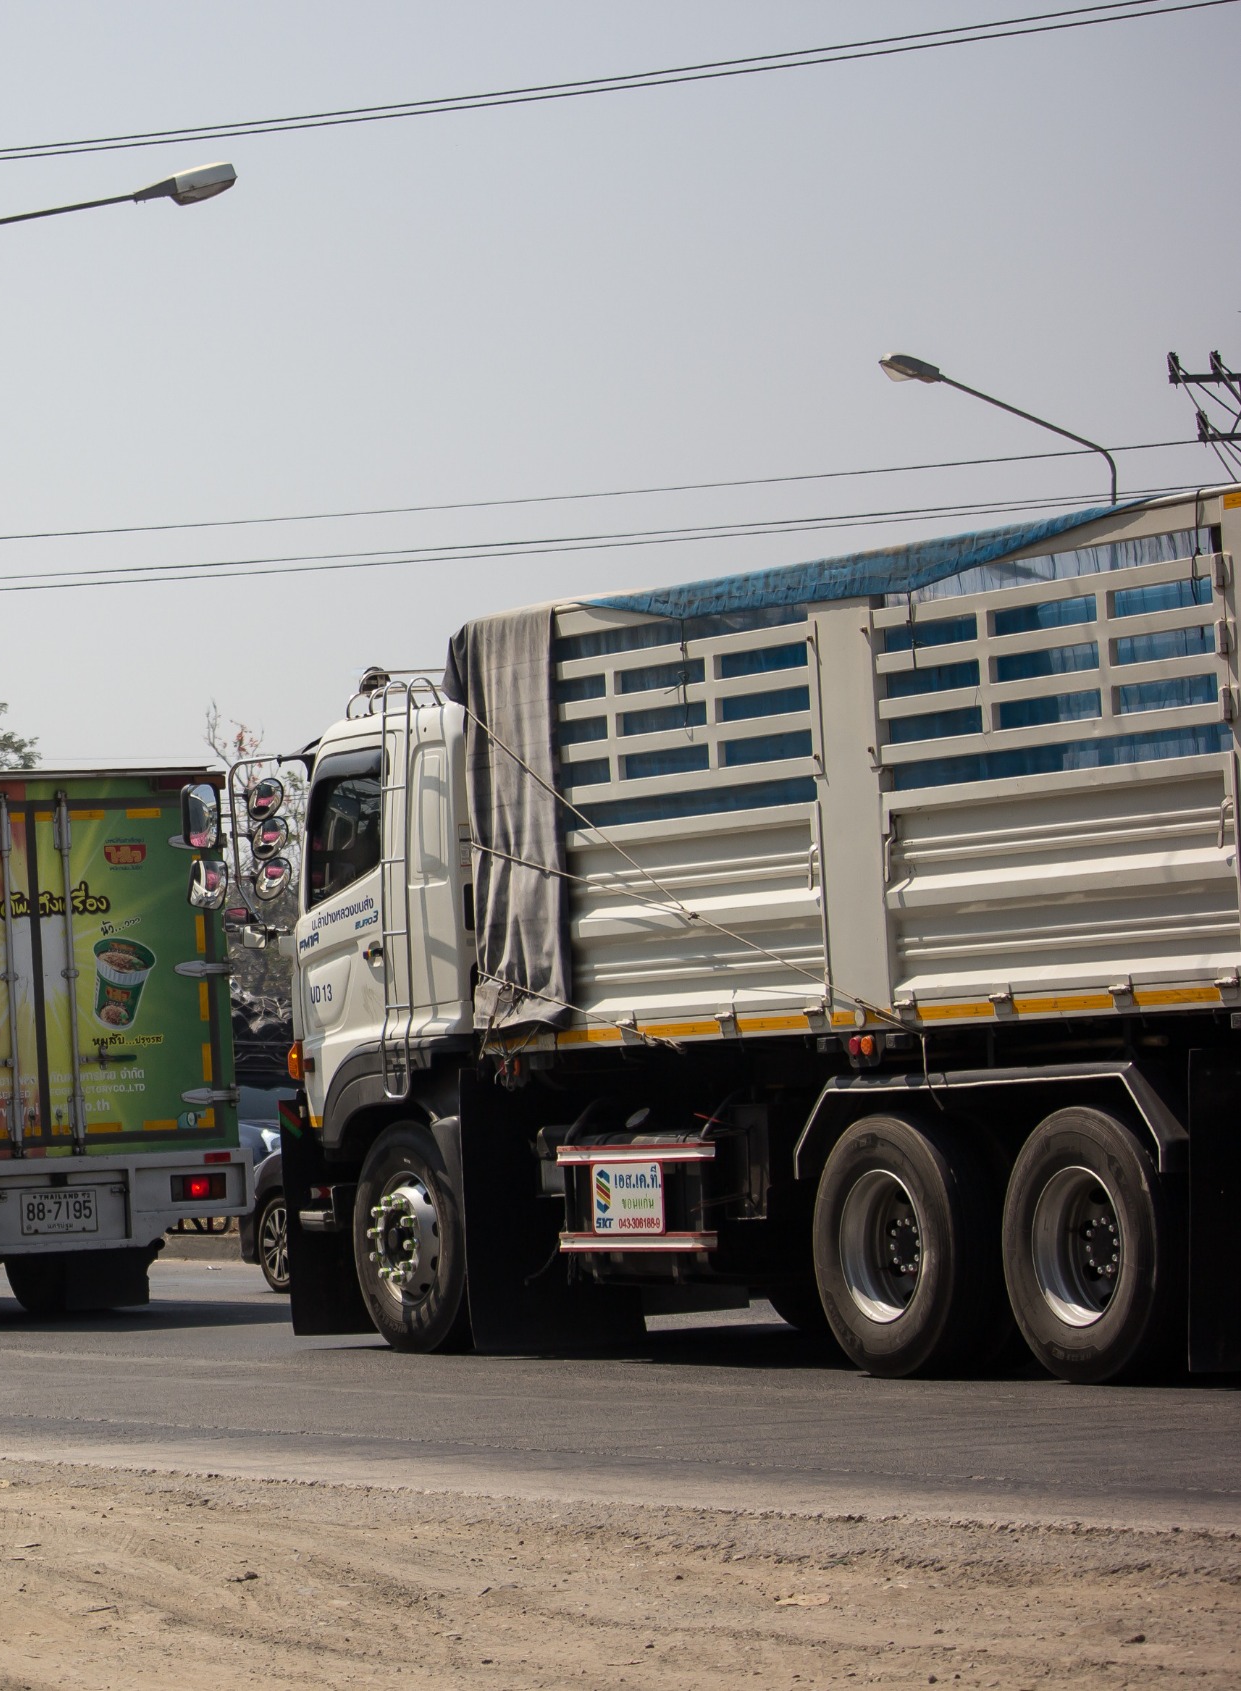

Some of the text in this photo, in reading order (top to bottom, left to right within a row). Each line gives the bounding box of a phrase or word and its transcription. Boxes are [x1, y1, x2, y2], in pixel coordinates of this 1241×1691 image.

[322, 984, 333, 1002] 13
[39, 1192, 79, 1201] THAILAND
[26, 1200, 93, 1222] 88-7195
[595, 1217, 614, 1229] SKT
